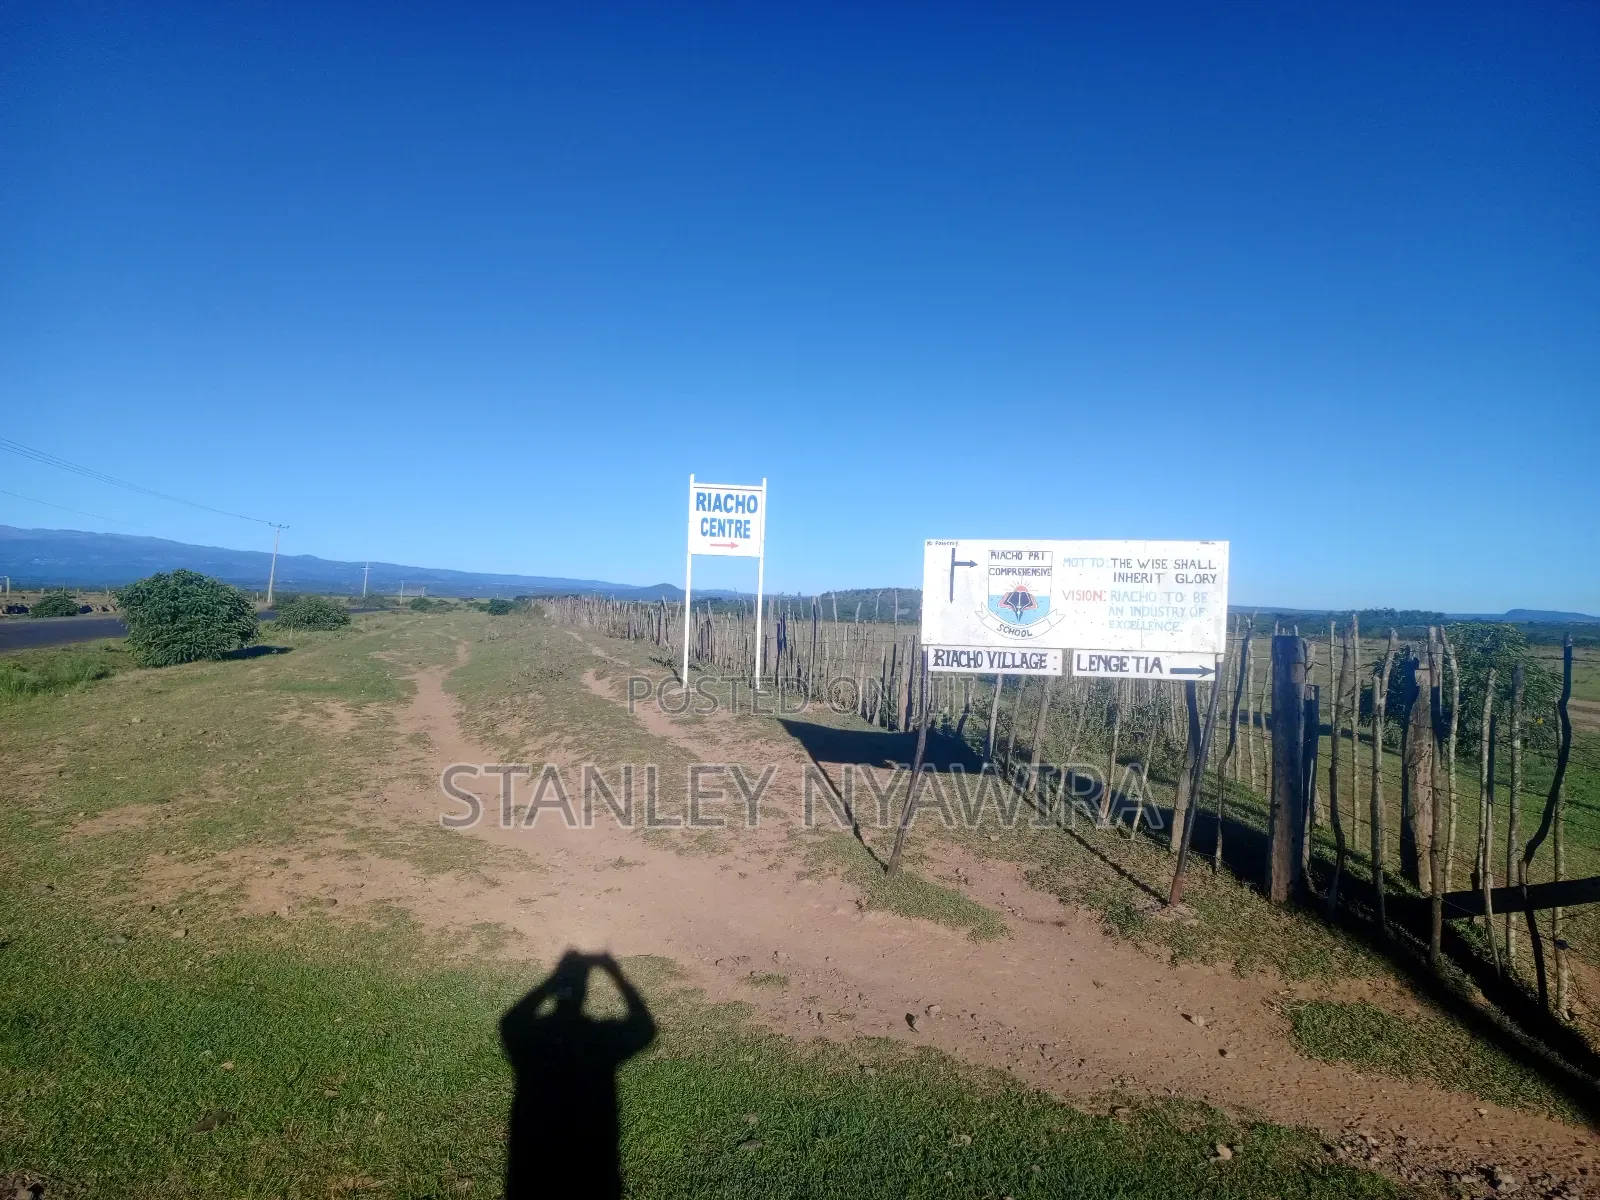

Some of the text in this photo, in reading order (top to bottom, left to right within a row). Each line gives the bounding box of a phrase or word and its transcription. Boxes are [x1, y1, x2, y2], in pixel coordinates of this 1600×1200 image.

[696, 492, 758, 514] RIACHO
[700, 517, 751, 539] CENTRE
[990, 551, 1045, 561] RIACHO PRI
[1110, 558, 1132, 569] THE
[1137, 558, 1168, 569] WISE
[1173, 559, 1217, 570] SHALL
[989, 568, 1051, 577] COMPREHENSIVE
[1113, 572, 1217, 584] INHERIT GLORY
[1062, 590, 1209, 603] VISION: RIACHO TO BE
[1108, 605, 1206, 618] AN INDUSTRY OF
[996, 623, 1033, 638] SCHOOL
[932, 648, 1049, 670] RIACHO VILLAGE
[1076, 653, 1163, 674] LENGETIA
